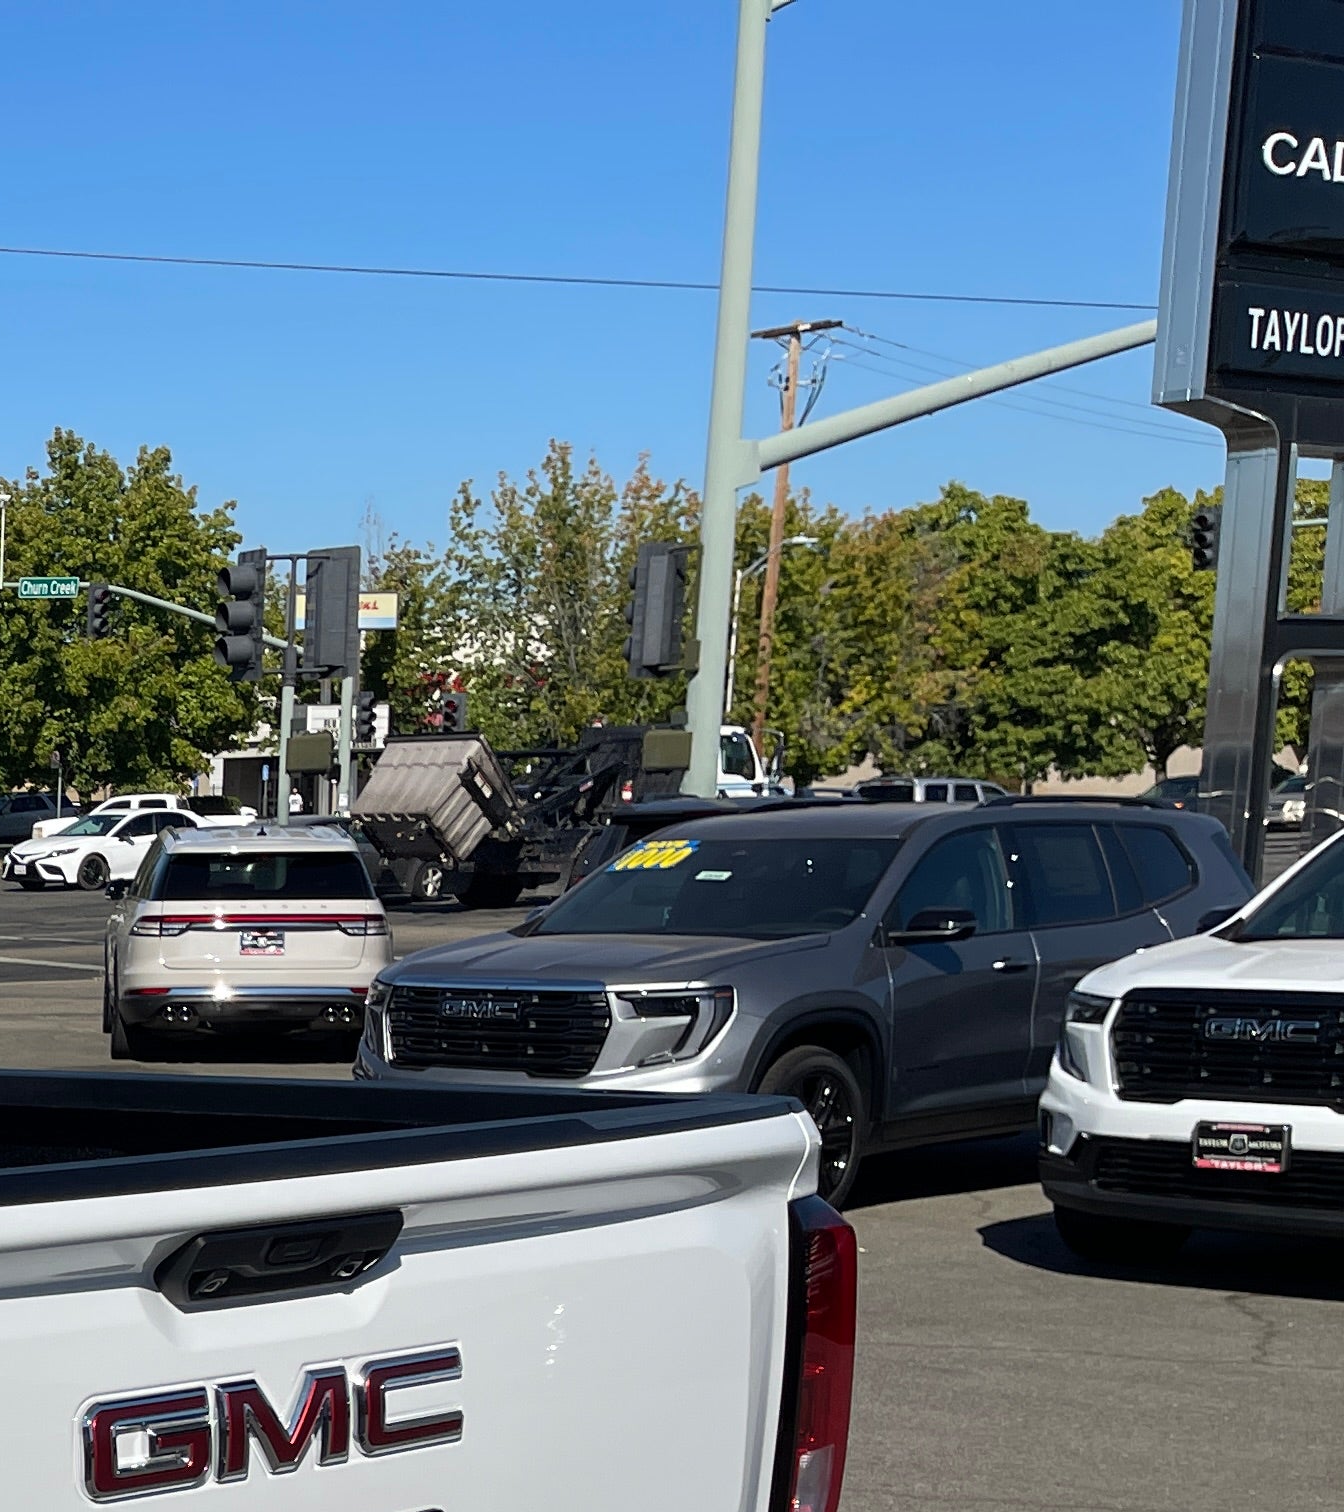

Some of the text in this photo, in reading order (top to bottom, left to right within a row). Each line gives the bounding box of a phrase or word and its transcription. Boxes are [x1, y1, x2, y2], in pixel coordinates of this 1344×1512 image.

[21, 580, 76, 595] Churn Creek
[441, 999, 519, 1020] GMC
[1205, 1018, 1320, 1043] GMC
[1212, 1159, 1264, 1172] TAYLOR
[77, 1341, 463, 1505] GMC
